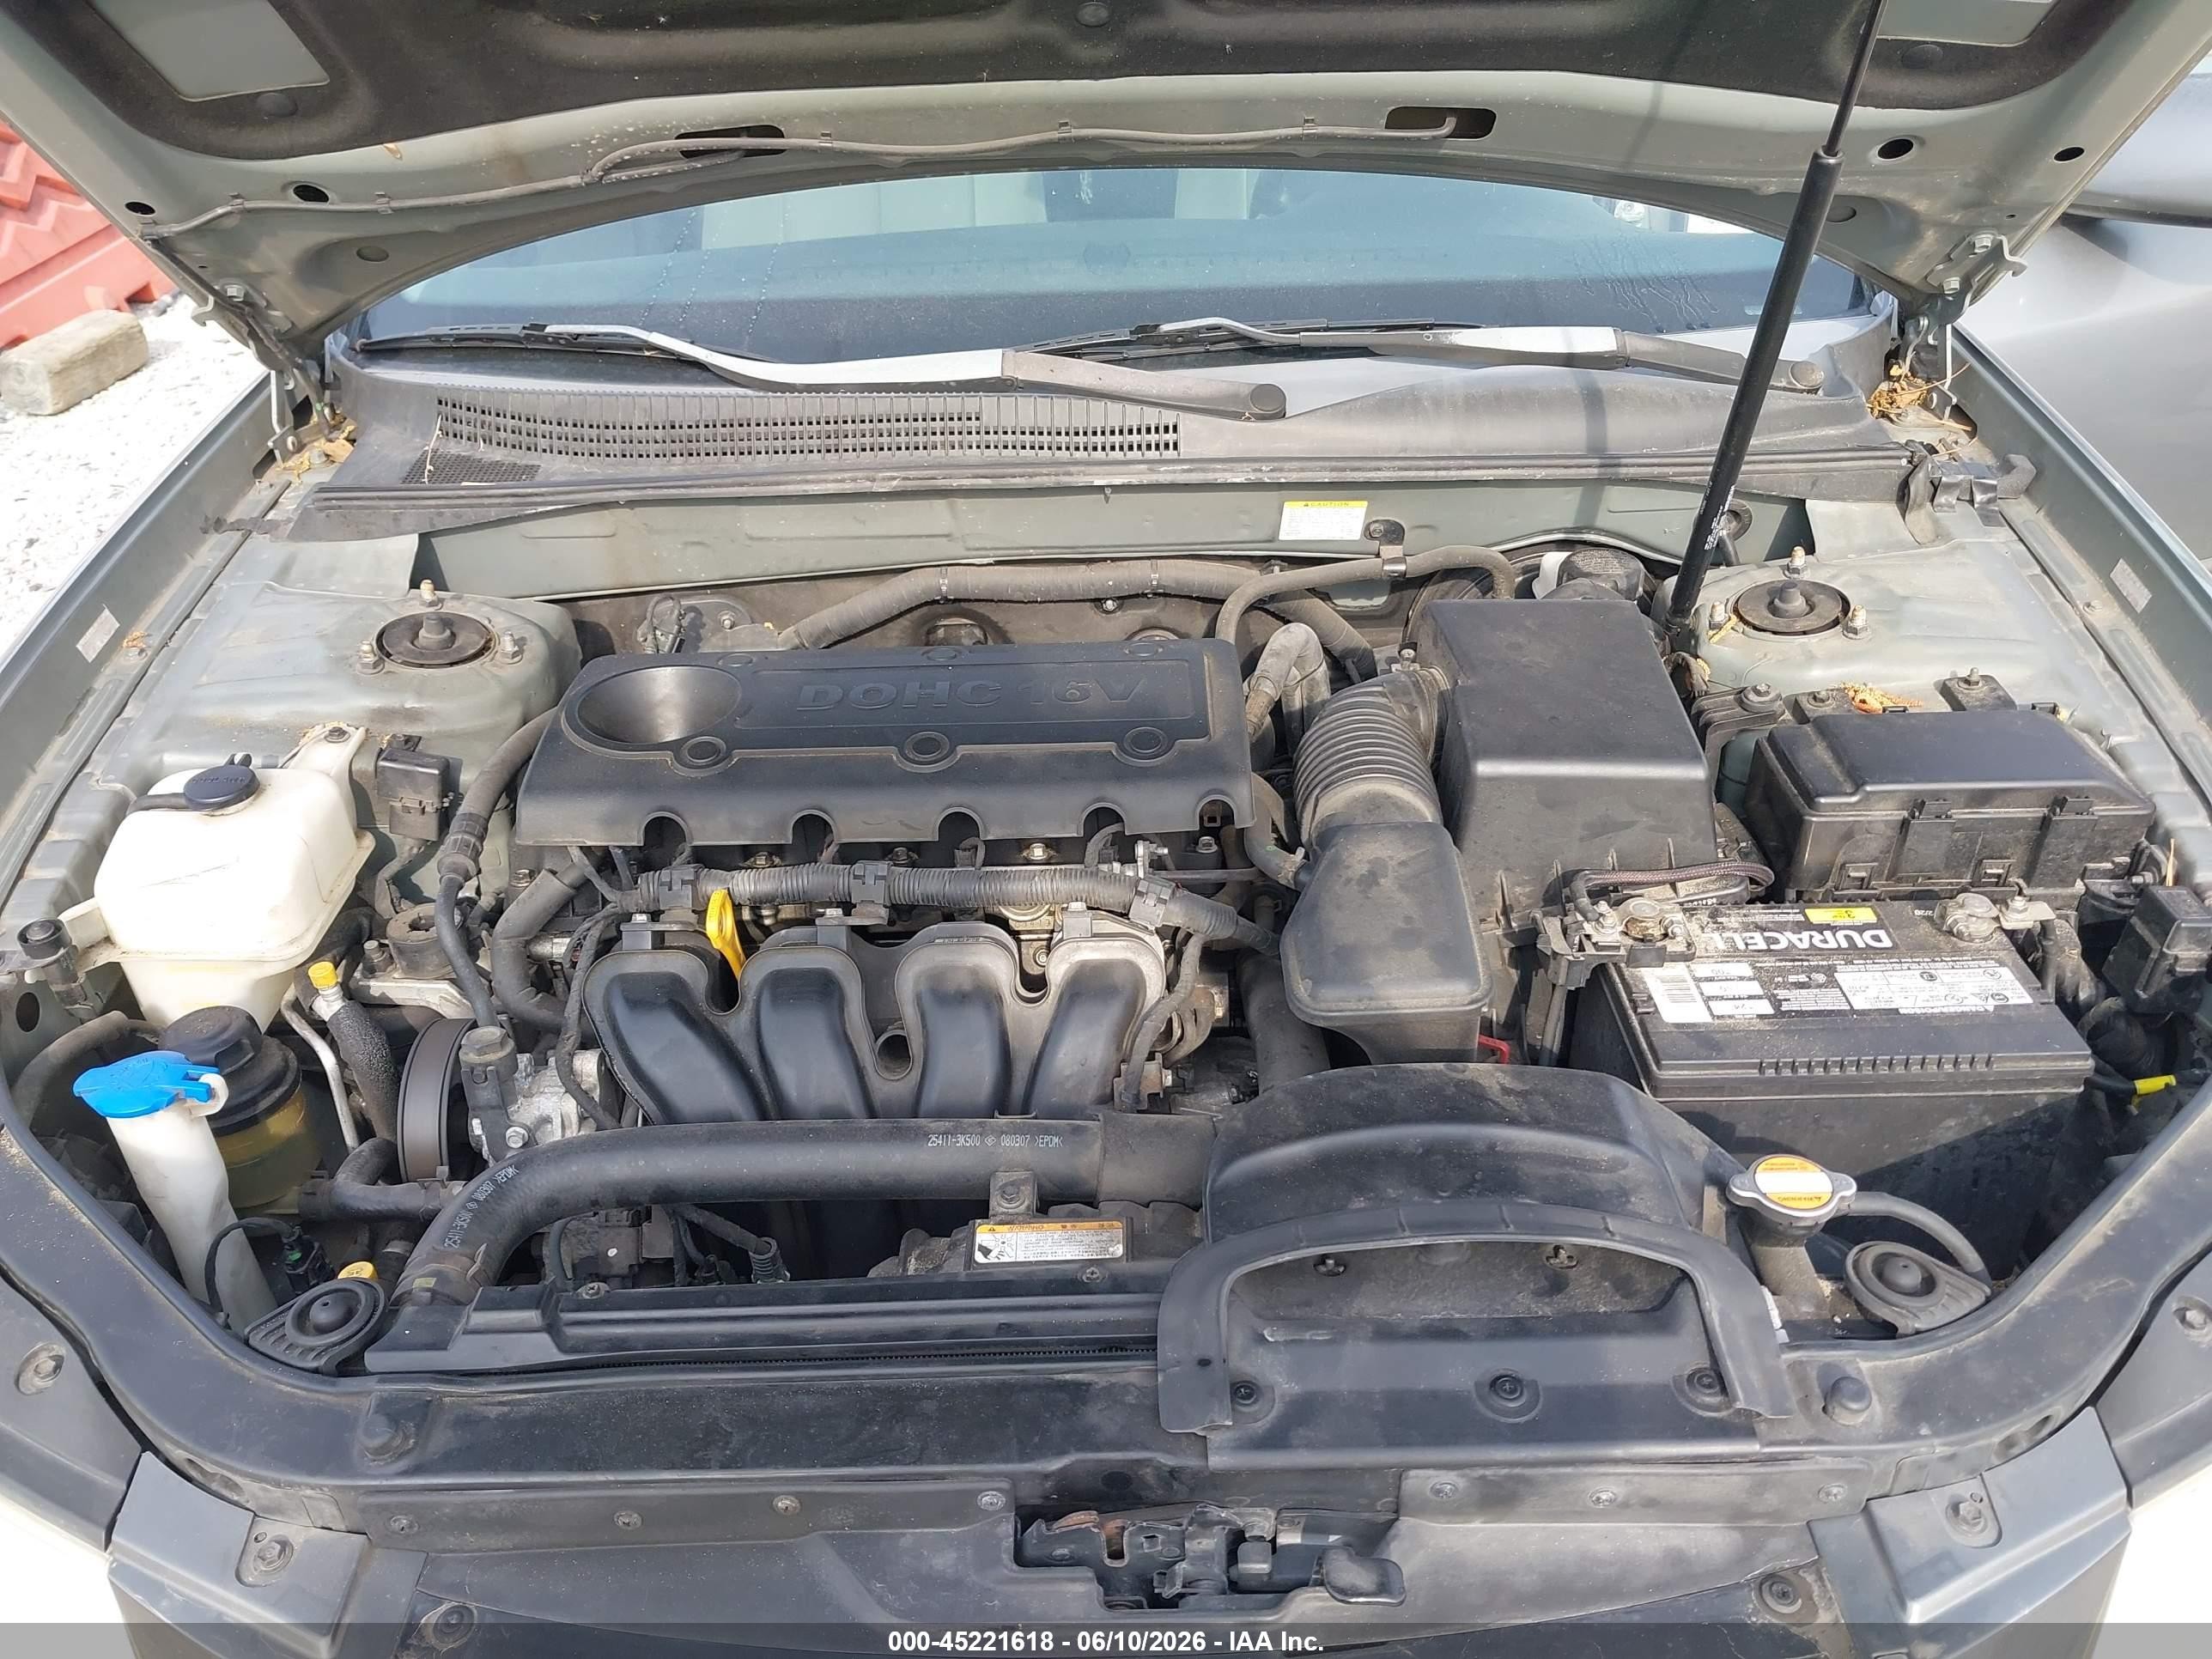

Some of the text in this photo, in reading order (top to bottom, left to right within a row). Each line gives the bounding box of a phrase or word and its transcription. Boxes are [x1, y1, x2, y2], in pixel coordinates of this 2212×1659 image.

[797, 678, 1145, 710] DOHC 16V
[1702, 928, 1893, 951] DURACELL
[927, 1134, 981, 1146] 25411-3K500
[1000, 1134, 1030, 1146] 080307
